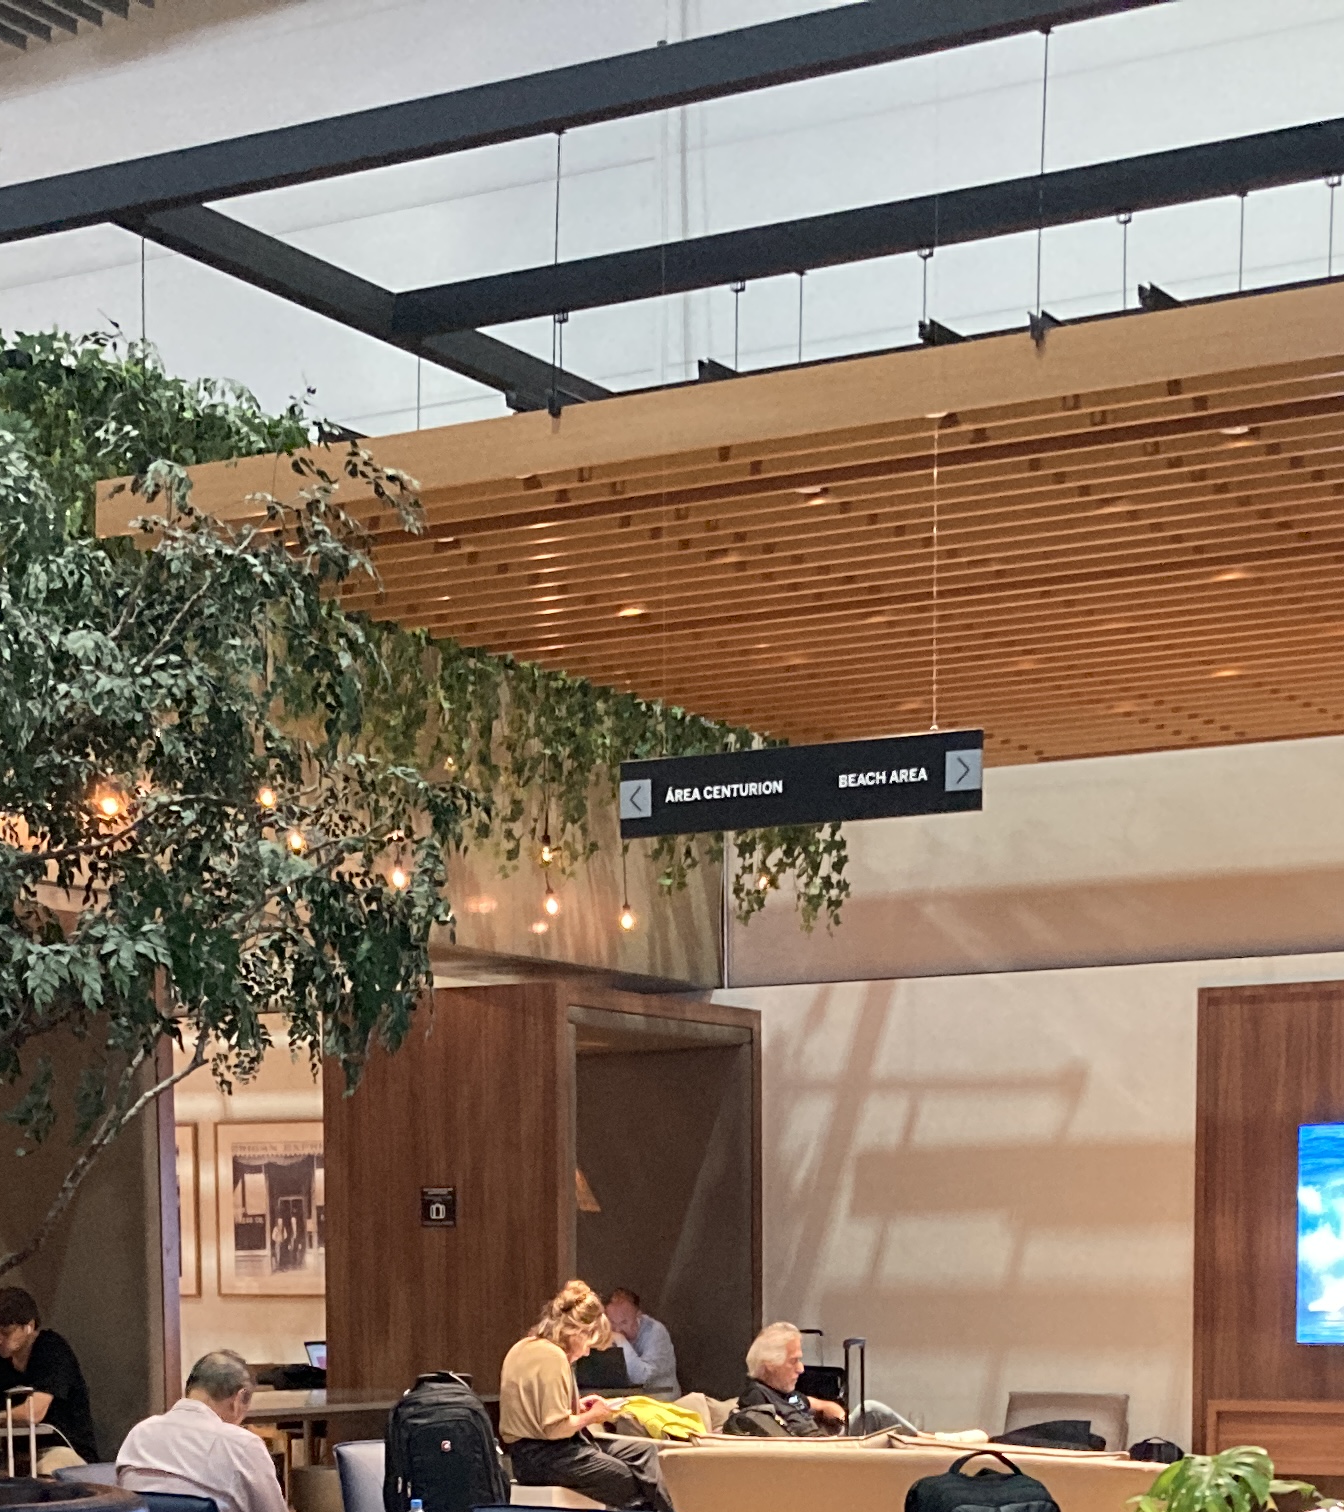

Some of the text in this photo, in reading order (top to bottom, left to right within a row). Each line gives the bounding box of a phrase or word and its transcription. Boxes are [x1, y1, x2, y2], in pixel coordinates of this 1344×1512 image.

[838, 767, 928, 789] BEACH AREA
[702, 780, 784, 801] CENTURION
